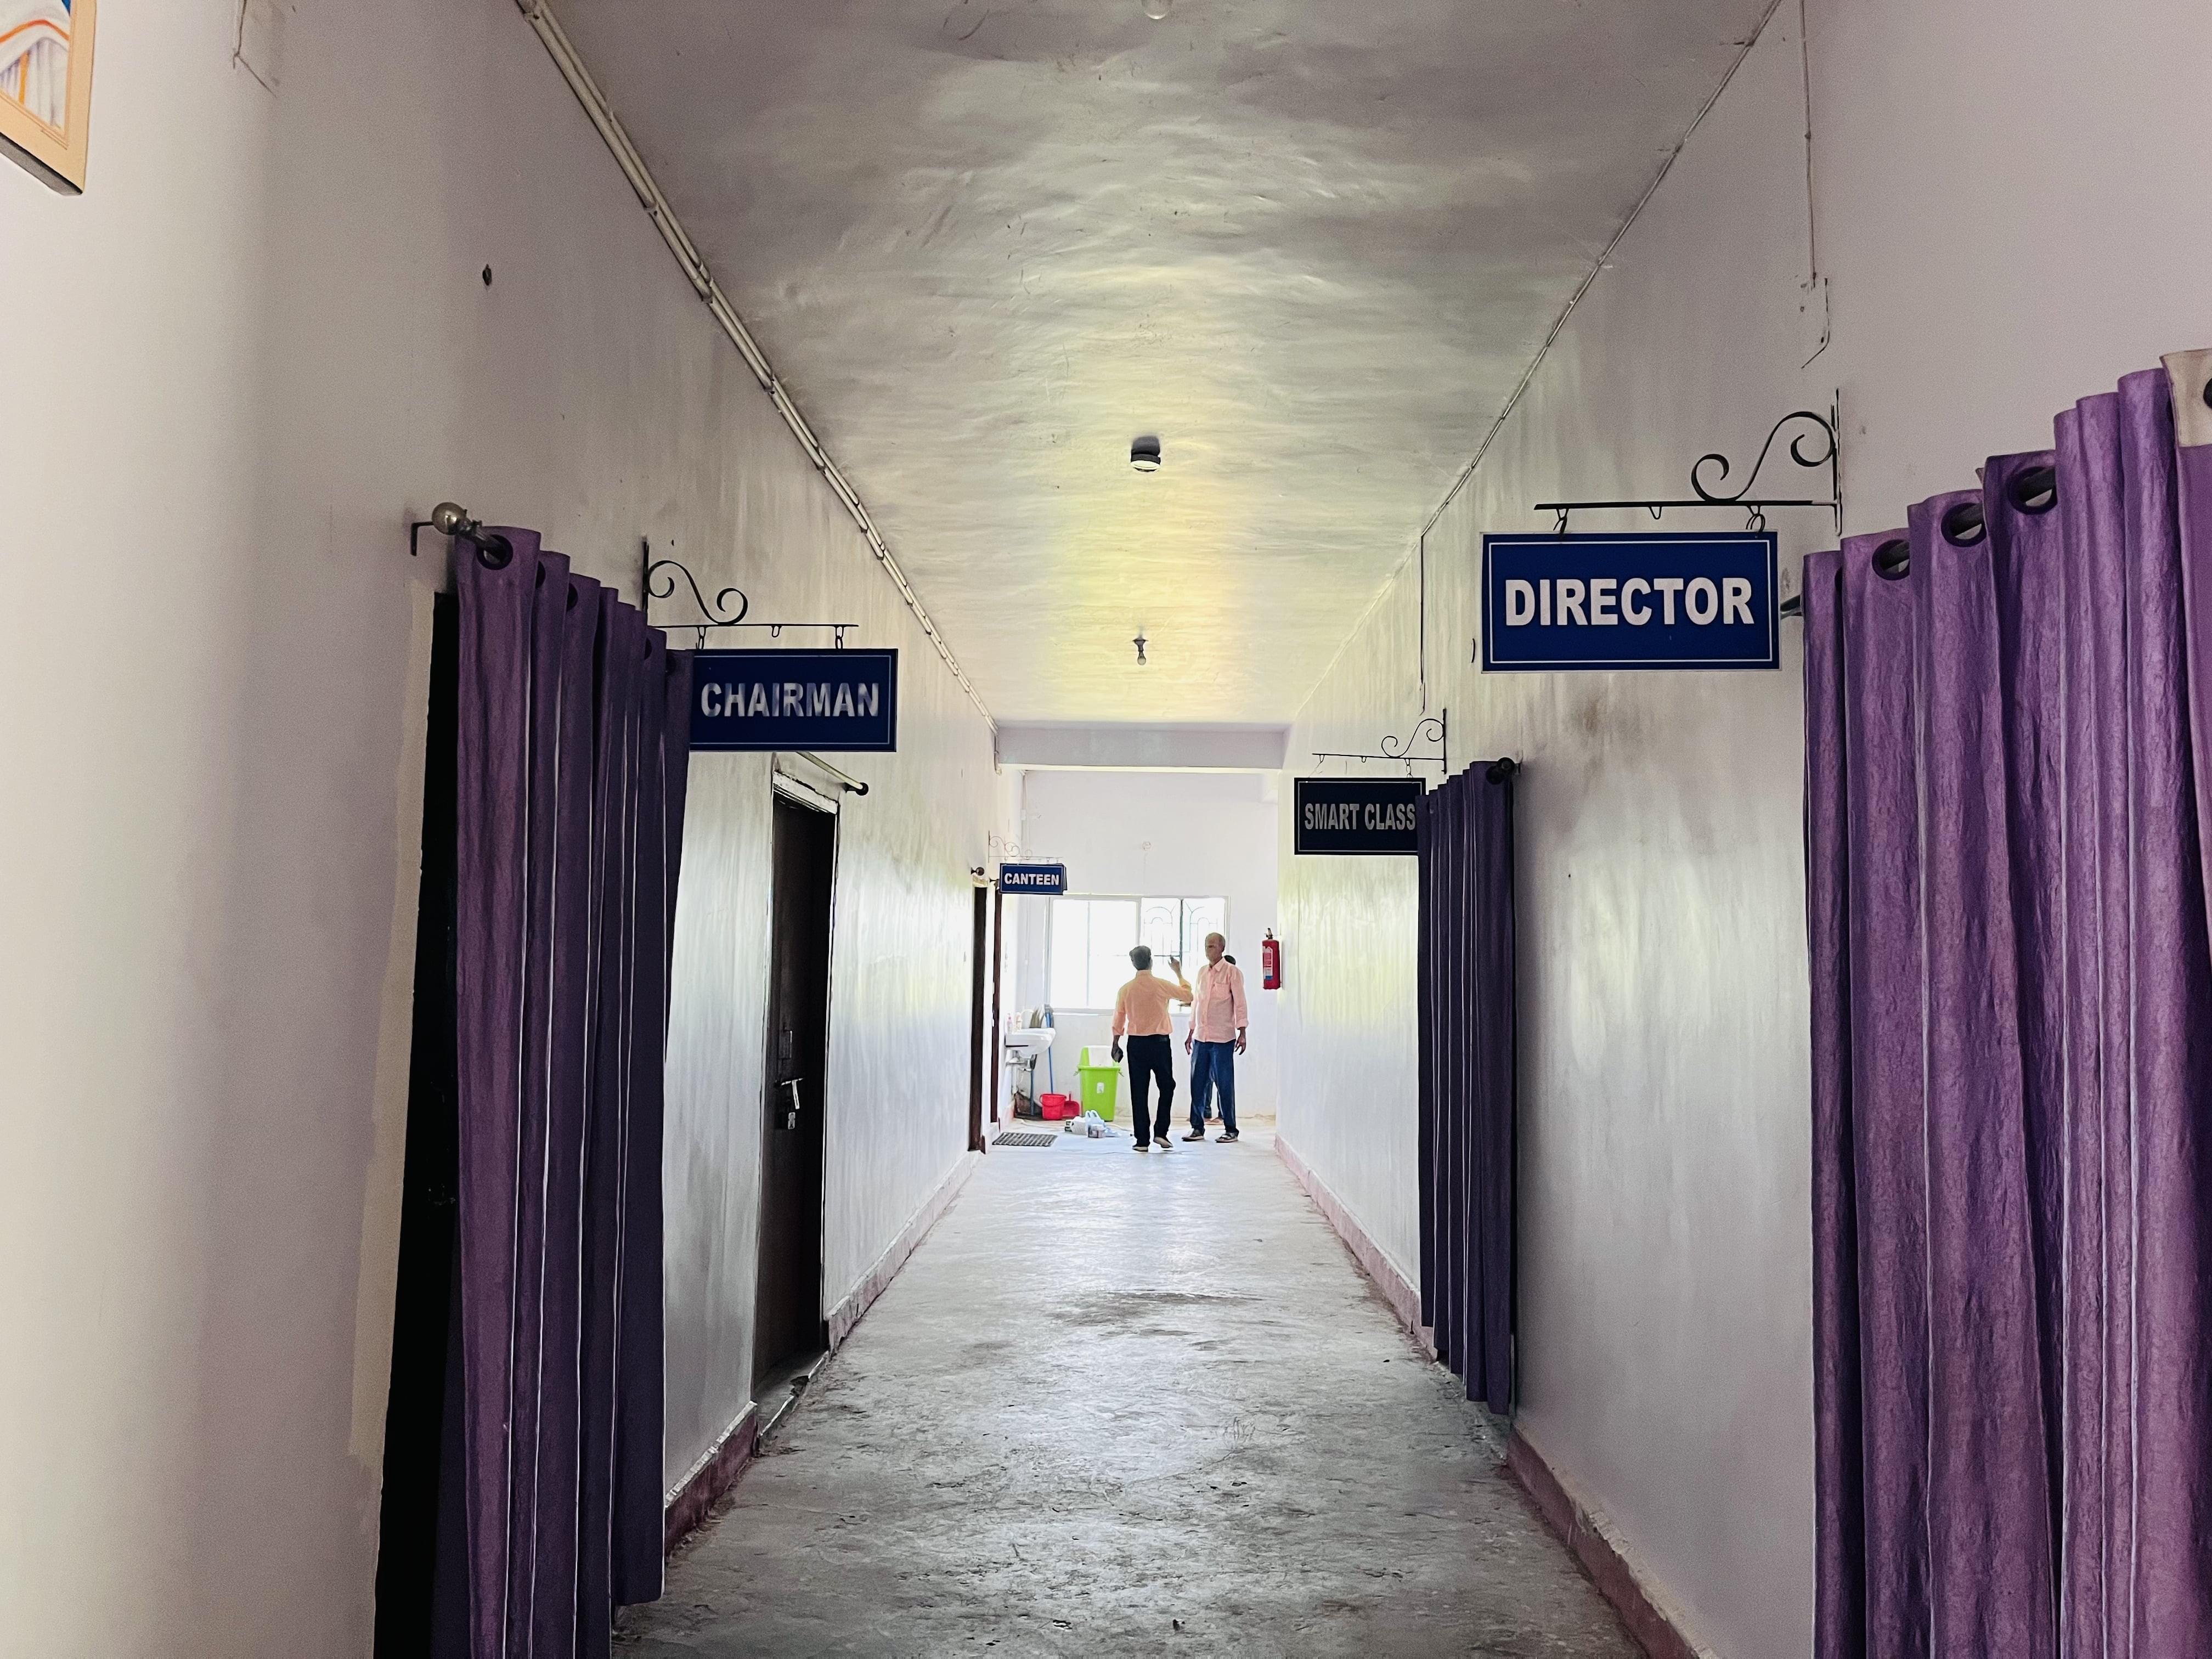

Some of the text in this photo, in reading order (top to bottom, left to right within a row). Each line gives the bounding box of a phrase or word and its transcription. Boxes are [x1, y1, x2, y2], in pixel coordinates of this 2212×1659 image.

[1505, 577, 1755, 626] DIRECTOR
[701, 682, 879, 717] CHAIRMAN
[1305, 803, 1416, 831] SMART CLASS
[1004, 873, 1059, 885] CANTEEN
